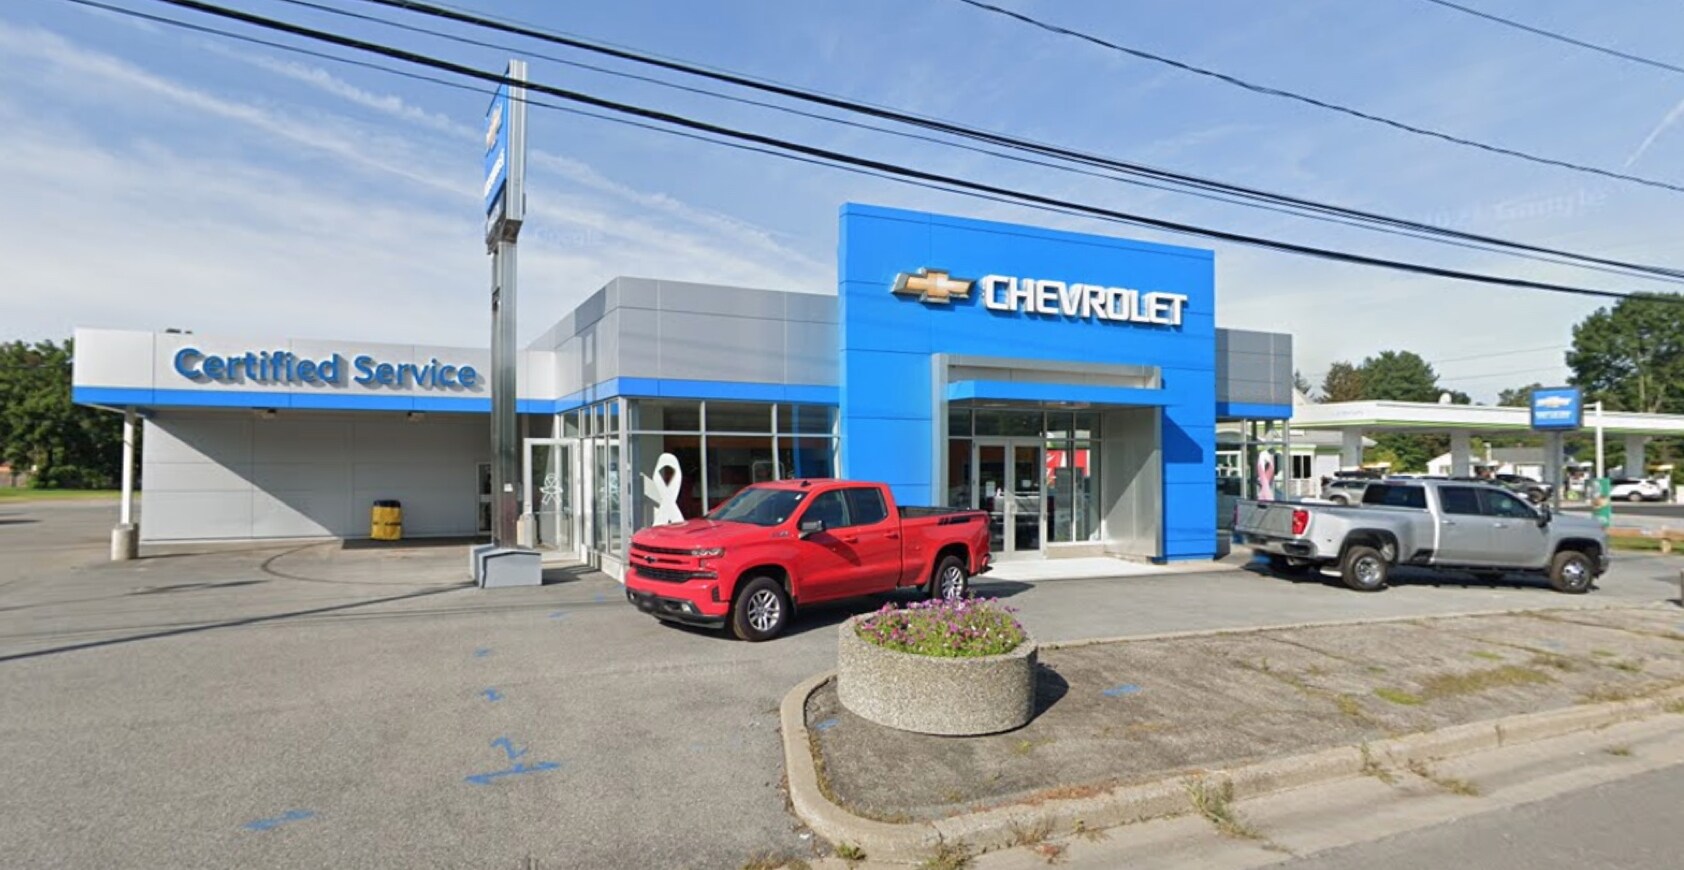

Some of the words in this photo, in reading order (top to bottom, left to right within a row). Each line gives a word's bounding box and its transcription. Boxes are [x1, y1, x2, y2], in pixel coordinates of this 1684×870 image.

[983, 274, 1187, 324] CHEVROLET
[174, 347, 341, 386] Certified
[353, 354, 478, 388] Service
